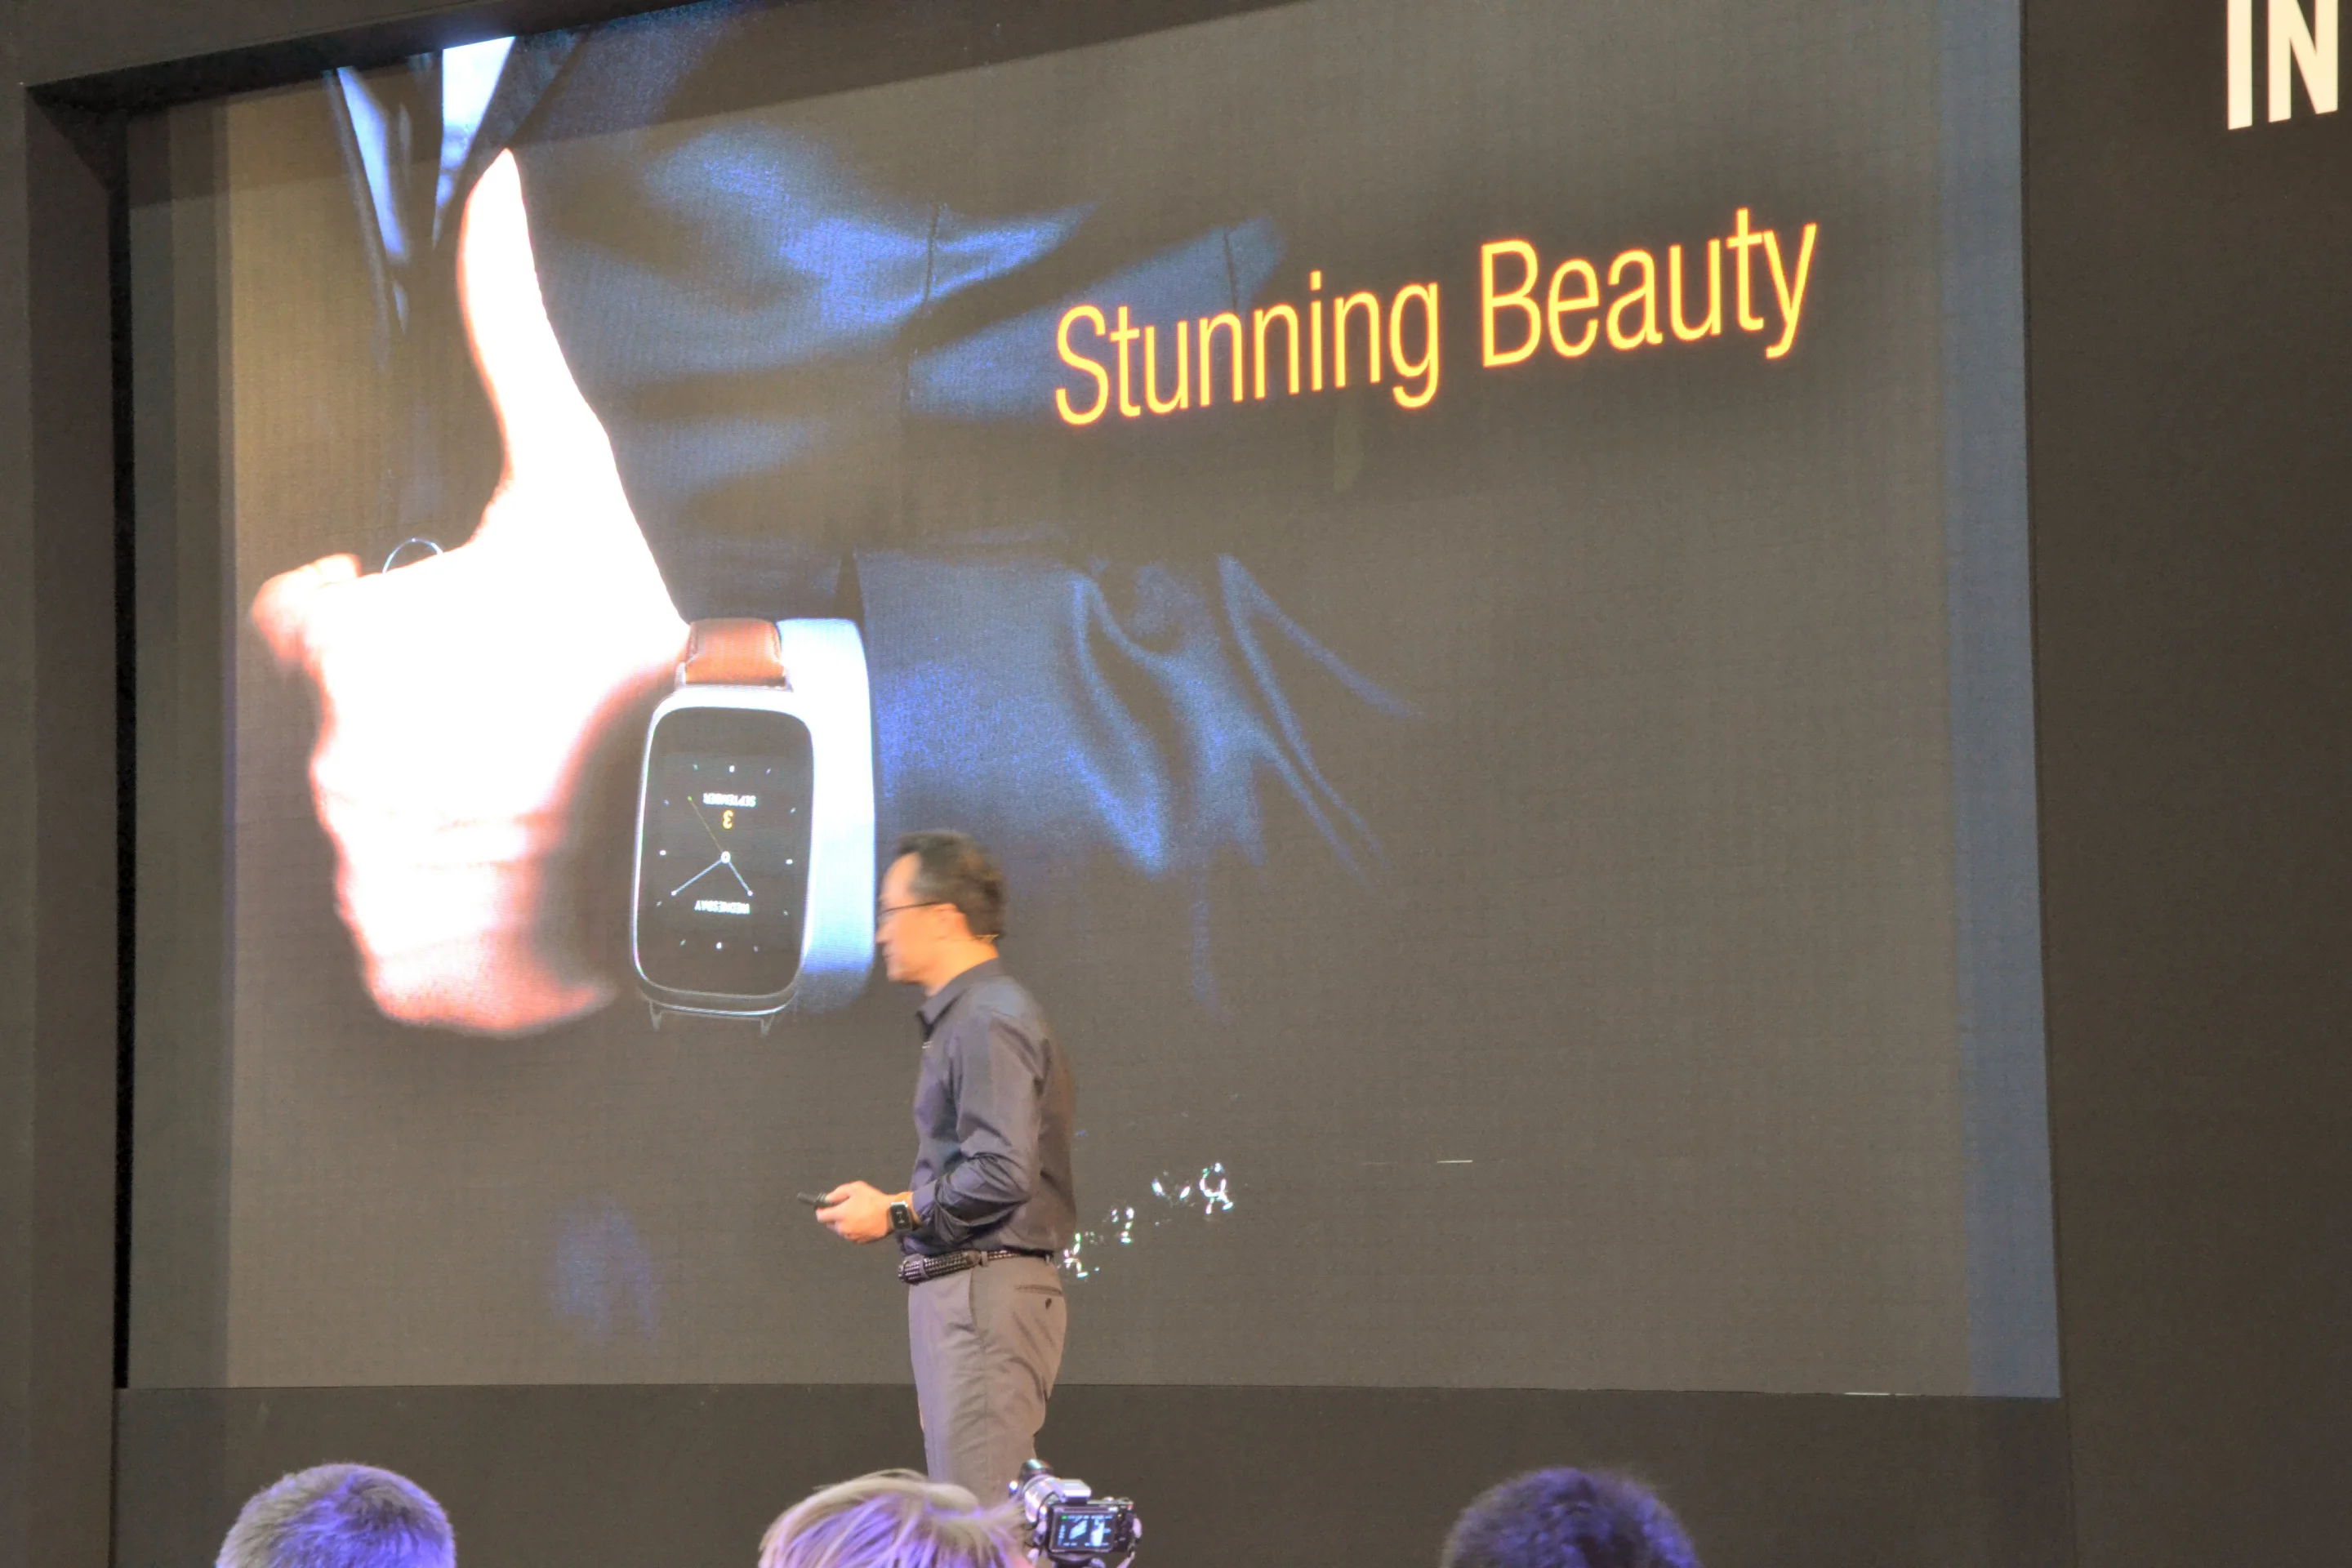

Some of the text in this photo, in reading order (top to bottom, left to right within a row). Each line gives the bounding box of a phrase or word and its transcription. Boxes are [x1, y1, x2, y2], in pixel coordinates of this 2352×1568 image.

[2227, 0, 2338, 130] IN
[1054, 207, 1818, 425] Stunning Beauty
[702, 792, 756, 807] SEPTEMBER
[722, 810, 733, 830] 3
[694, 901, 751, 915] WEDNESDAY
